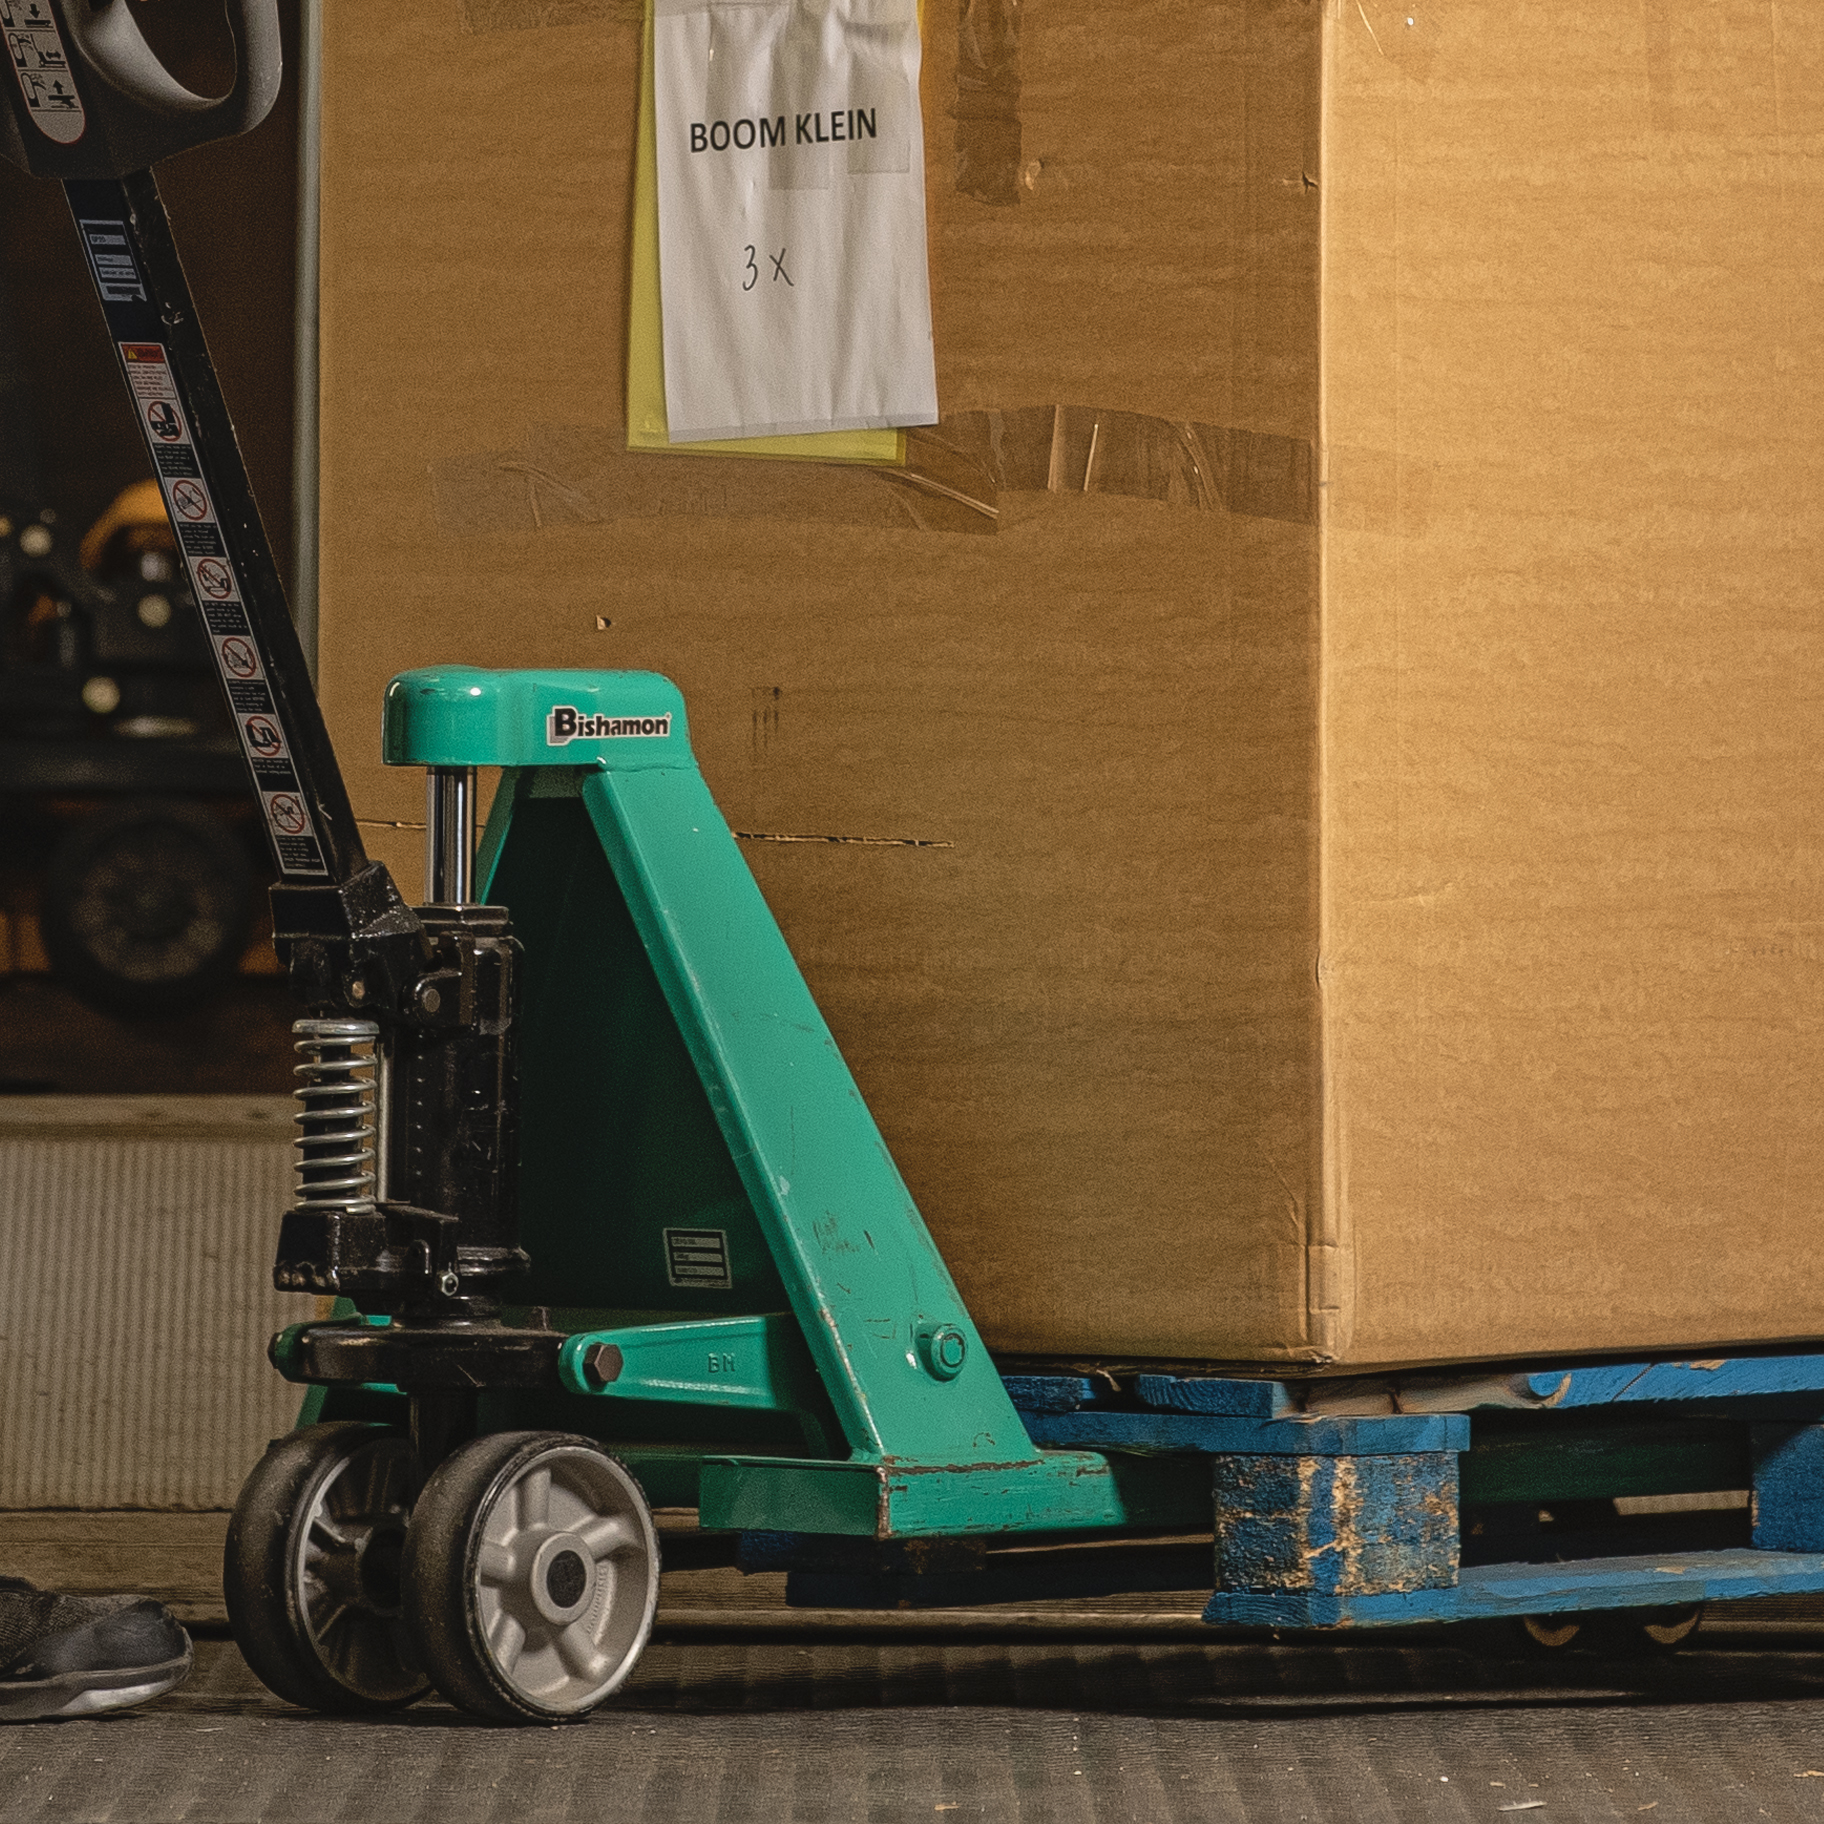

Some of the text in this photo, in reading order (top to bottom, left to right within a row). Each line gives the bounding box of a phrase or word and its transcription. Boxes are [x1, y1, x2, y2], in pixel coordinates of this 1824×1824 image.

[690, 107, 877, 153] BOOM KLEIN
[552, 708, 669, 737] Bishamon
